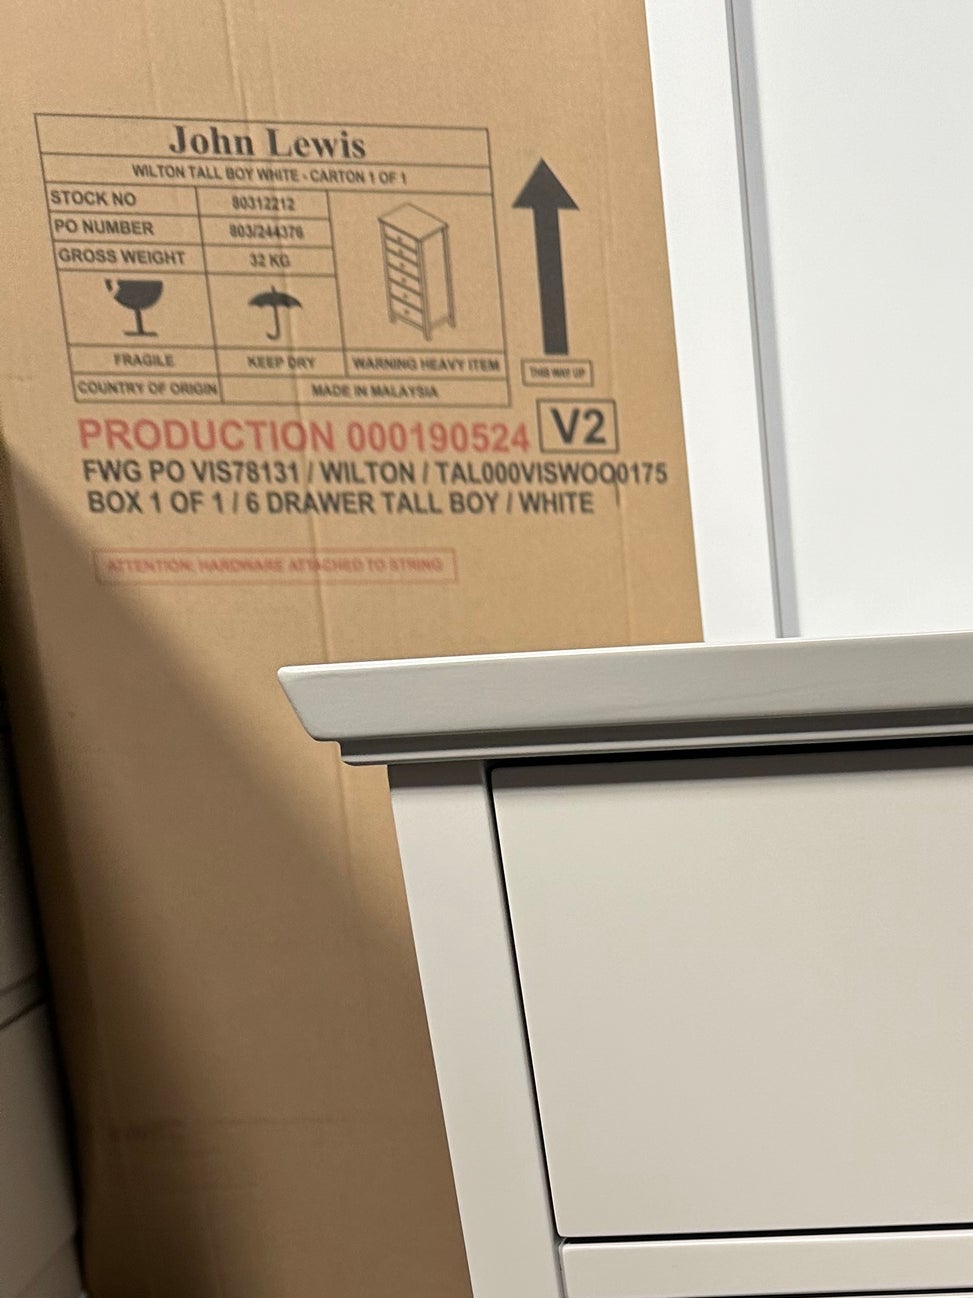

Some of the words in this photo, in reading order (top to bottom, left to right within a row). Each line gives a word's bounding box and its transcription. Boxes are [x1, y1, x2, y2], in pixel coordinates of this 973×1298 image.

[169, 124, 254, 156] John
[266, 128, 367, 160] Lewis
[132, 164, 185, 180] WILTON
[190, 165, 222, 180] TALL
[226, 166, 253, 181] BOY
[257, 168, 299, 183] WHITE
[310, 170, 365, 185] CARTON
[369, 171, 375, 185] 1
[380, 171, 397, 185] OF
[402, 172, 408, 185] 1
[51, 190, 108, 207] STOCK
[114, 191, 137, 207] NO
[232, 195, 295, 212] 80312212
[54, 218, 78, 234] PO
[83, 219, 154, 235] NUMBER
[59, 248, 117, 264] GROSS
[122, 250, 186, 265] WEIGHT
[249, 253, 266, 268] 32
[269, 254, 291, 268] KG
[113, 353, 175, 368] FRAGILE
[247, 355, 284, 369] KEEP
[287, 356, 316, 370] DRY
[352, 357, 417, 370] WARNING
[421, 358, 465, 371] HEAVY
[468, 358, 500, 372] ITEM
[529, 366, 550, 378] THIS
[551, 367, 571, 379] WAY
[573, 367, 586, 379] UP
[77, 380, 144, 394] COUNTRY
[150, 381, 166, 394] OF
[170, 381, 218, 395] ORIGIN
[311, 384, 350, 397] MADE
[354, 384, 368, 397] IN
[370, 384, 439, 398] MALAYSIA
[550, 408, 606, 444] V2
[77, 417, 336, 453] PRODUCTION
[346, 420, 530, 454] 000190524
[82, 458, 142, 483] FWG
[149, 459, 185, 483] PO
[191, 459, 299, 484] VIS78131
[307, 460, 314, 483] /
[319, 460, 415, 484] WILTON
[422, 461, 429, 484] /
[88, 490, 143, 514] BOX
[151, 490, 161, 513] 1
[170, 490, 204, 514] OF
[213, 490, 224, 513] 1
[232, 490, 239, 514] /
[246, 490, 260, 514] 6
[266, 490, 375, 514] DRAWER
[381, 490, 443, 514] TALL
[449, 490, 498, 515] BOY
[506, 491, 514, 514] /
[519, 491, 594, 515] WHITE
